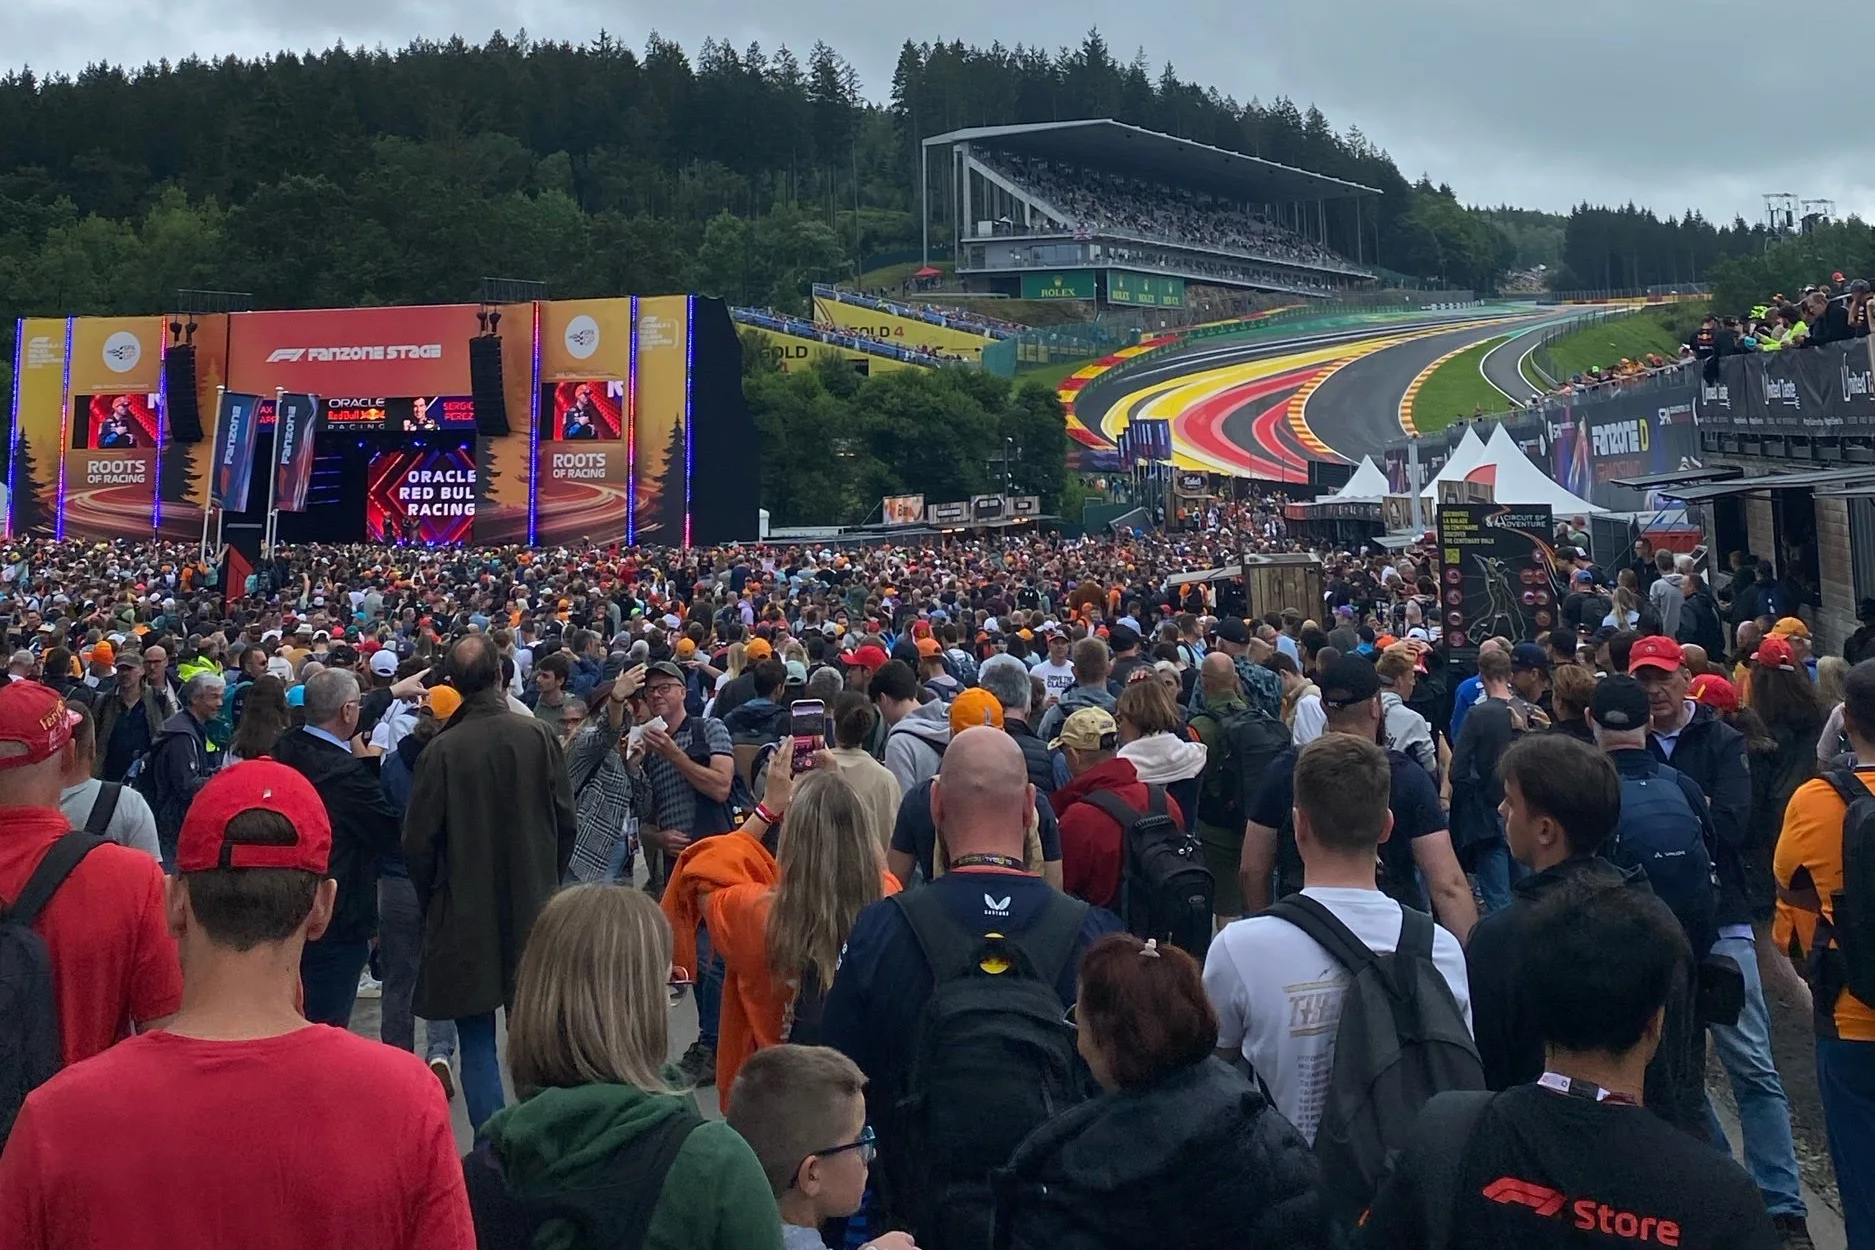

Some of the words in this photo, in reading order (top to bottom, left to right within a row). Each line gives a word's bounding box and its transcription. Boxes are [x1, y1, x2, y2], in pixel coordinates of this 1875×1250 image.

[1041, 288, 1076, 297] ROLEX
[1112, 290, 1130, 300] ROLEX
[1138, 293, 1155, 303] ROLEX
[1163, 296, 1179, 305] ROLEX
[894, 326, 905, 337] 4
[308, 346, 386, 361] FANZONE
[386, 344, 442, 359] STAGE
[1841, 358, 1867, 402] United
[1761, 367, 1782, 405] United
[1780, 378, 1797, 398] Taste
[328, 398, 385, 408] ORACLE
[260, 406, 273, 414] AX
[327, 410, 343, 421] Red
[343, 410, 360, 420] Bull
[444, 412, 475, 421] PEREZ
[1591, 419, 1640, 456] FANZONE
[1639, 418, 1649, 452] D
[553, 453, 606, 468] ROOTS
[87, 460, 146, 474] ROOTS
[87, 474, 102, 484] OF
[103, 474, 146, 484] RACING
[408, 470, 477, 483] ORACLE
[553, 468, 567, 478] OF
[567, 468, 606, 479] RACING
[399, 486, 434, 500] RED
[440, 486, 475, 500] BUL
[407, 503, 476, 516] RACING
[1485, 516, 1493, 527] &
[1573, 1199, 1682, 1248] Store
